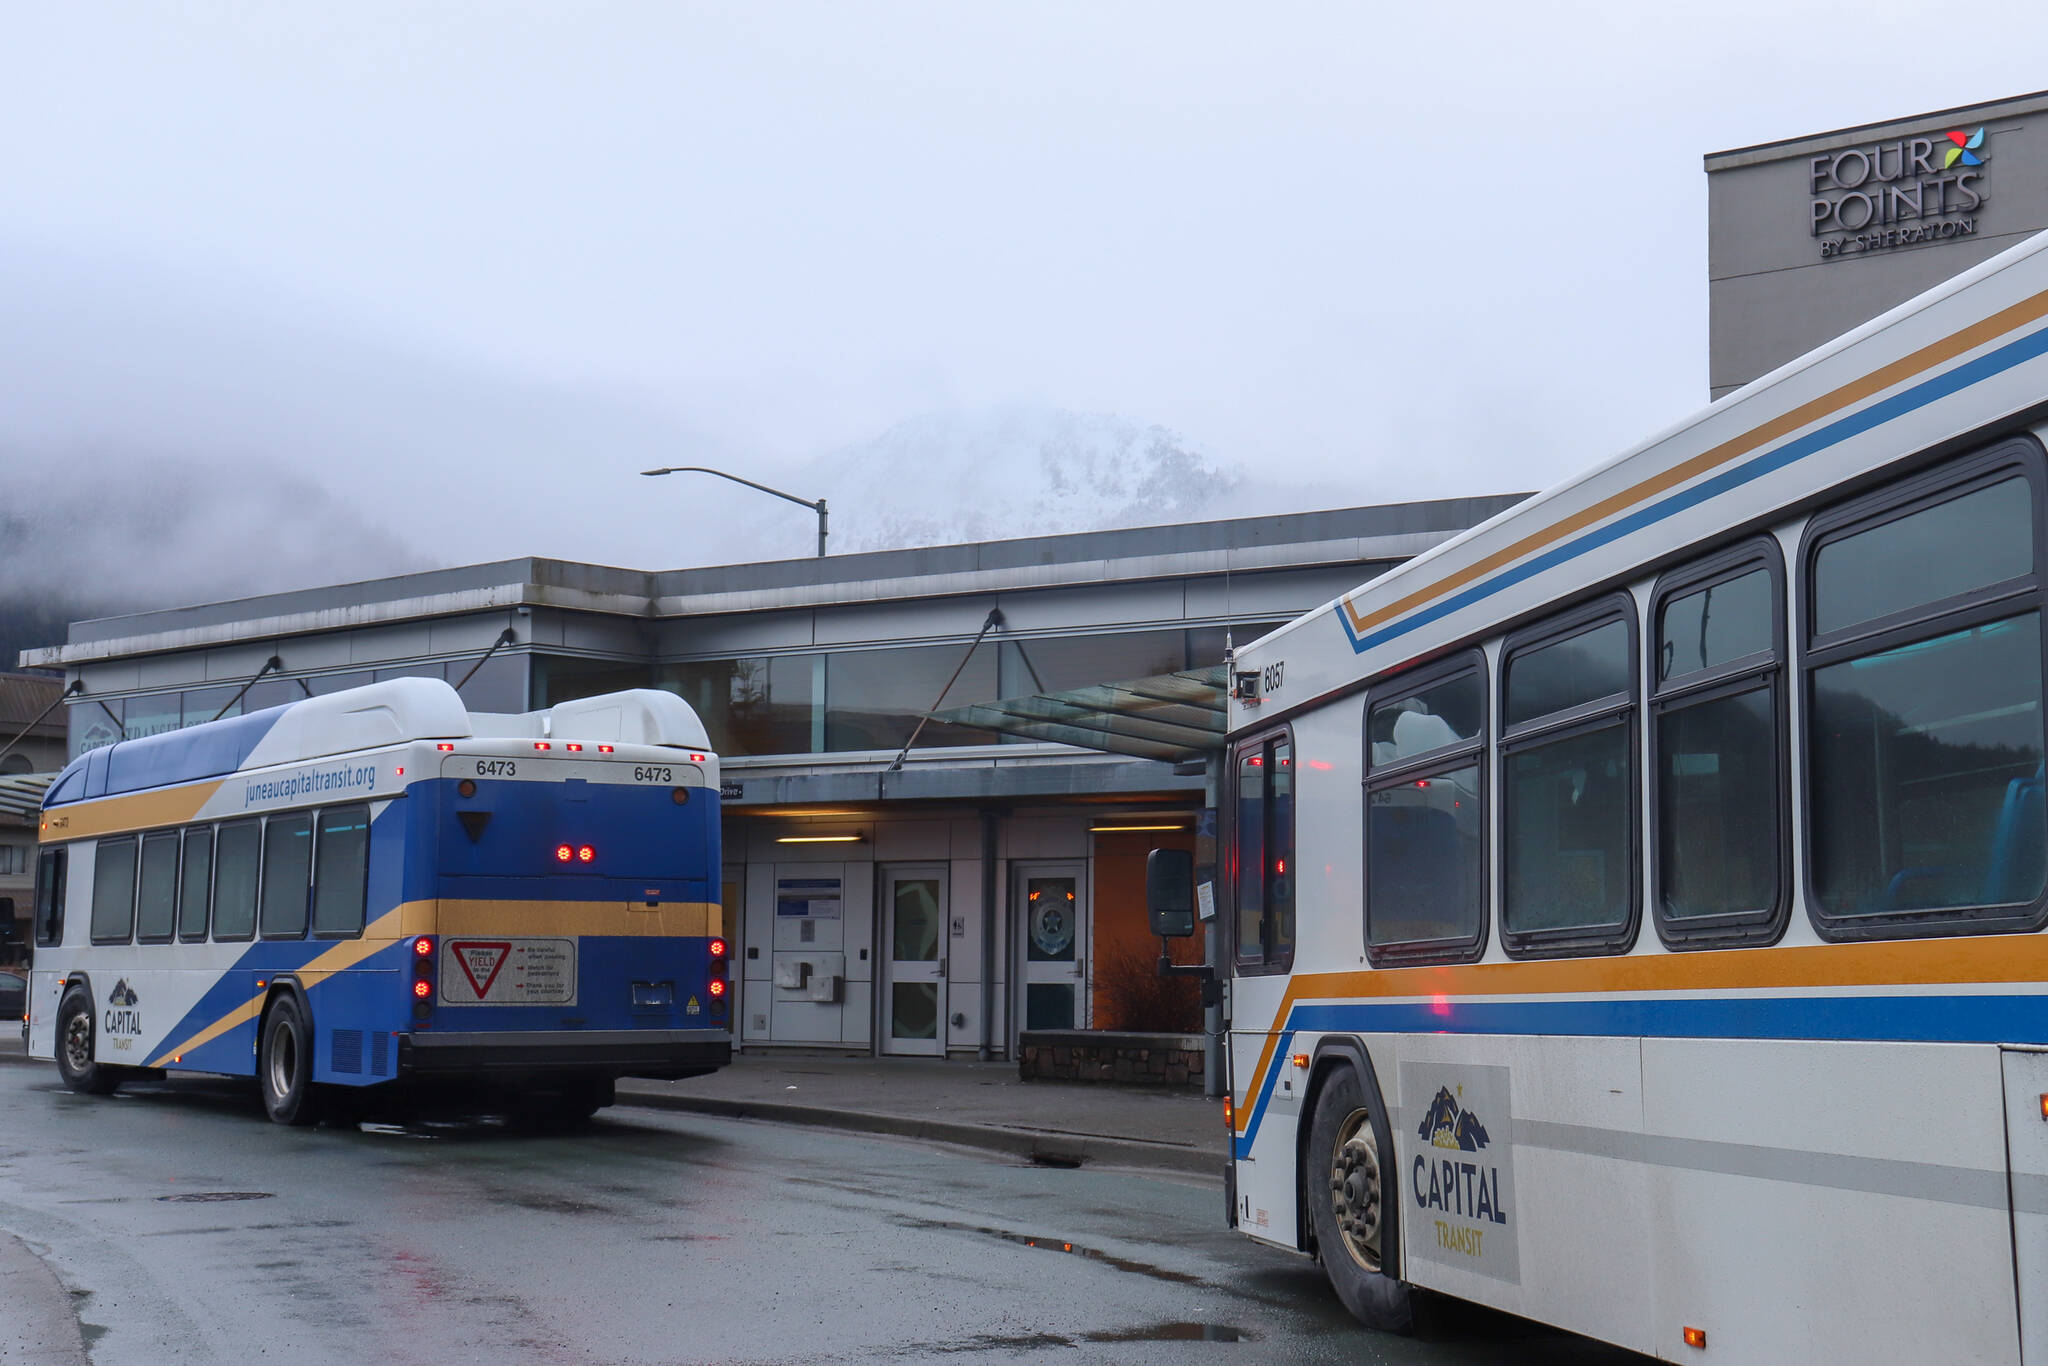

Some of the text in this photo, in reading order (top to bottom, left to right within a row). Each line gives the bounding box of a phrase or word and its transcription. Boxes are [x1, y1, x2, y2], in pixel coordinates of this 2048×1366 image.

[1810, 138, 1938, 195] FOUR
[1810, 172, 1983, 237] POINTS
[1820, 218, 1975, 257] BY SHERATON
[1265, 661, 1285, 692] 6057
[476, 760, 516, 776] 6473
[634, 766, 672, 782] 6473
[245, 764, 375, 808] juneaucapitaltransit.org
[469, 957, 496, 967] YIELD
[105, 1010, 142, 1035] CAPITAL
[113, 1038, 132, 1050] TRANSIT
[1413, 1154, 1506, 1225] CAPITAL
[1435, 1220, 1483, 1257] TRANSIT
